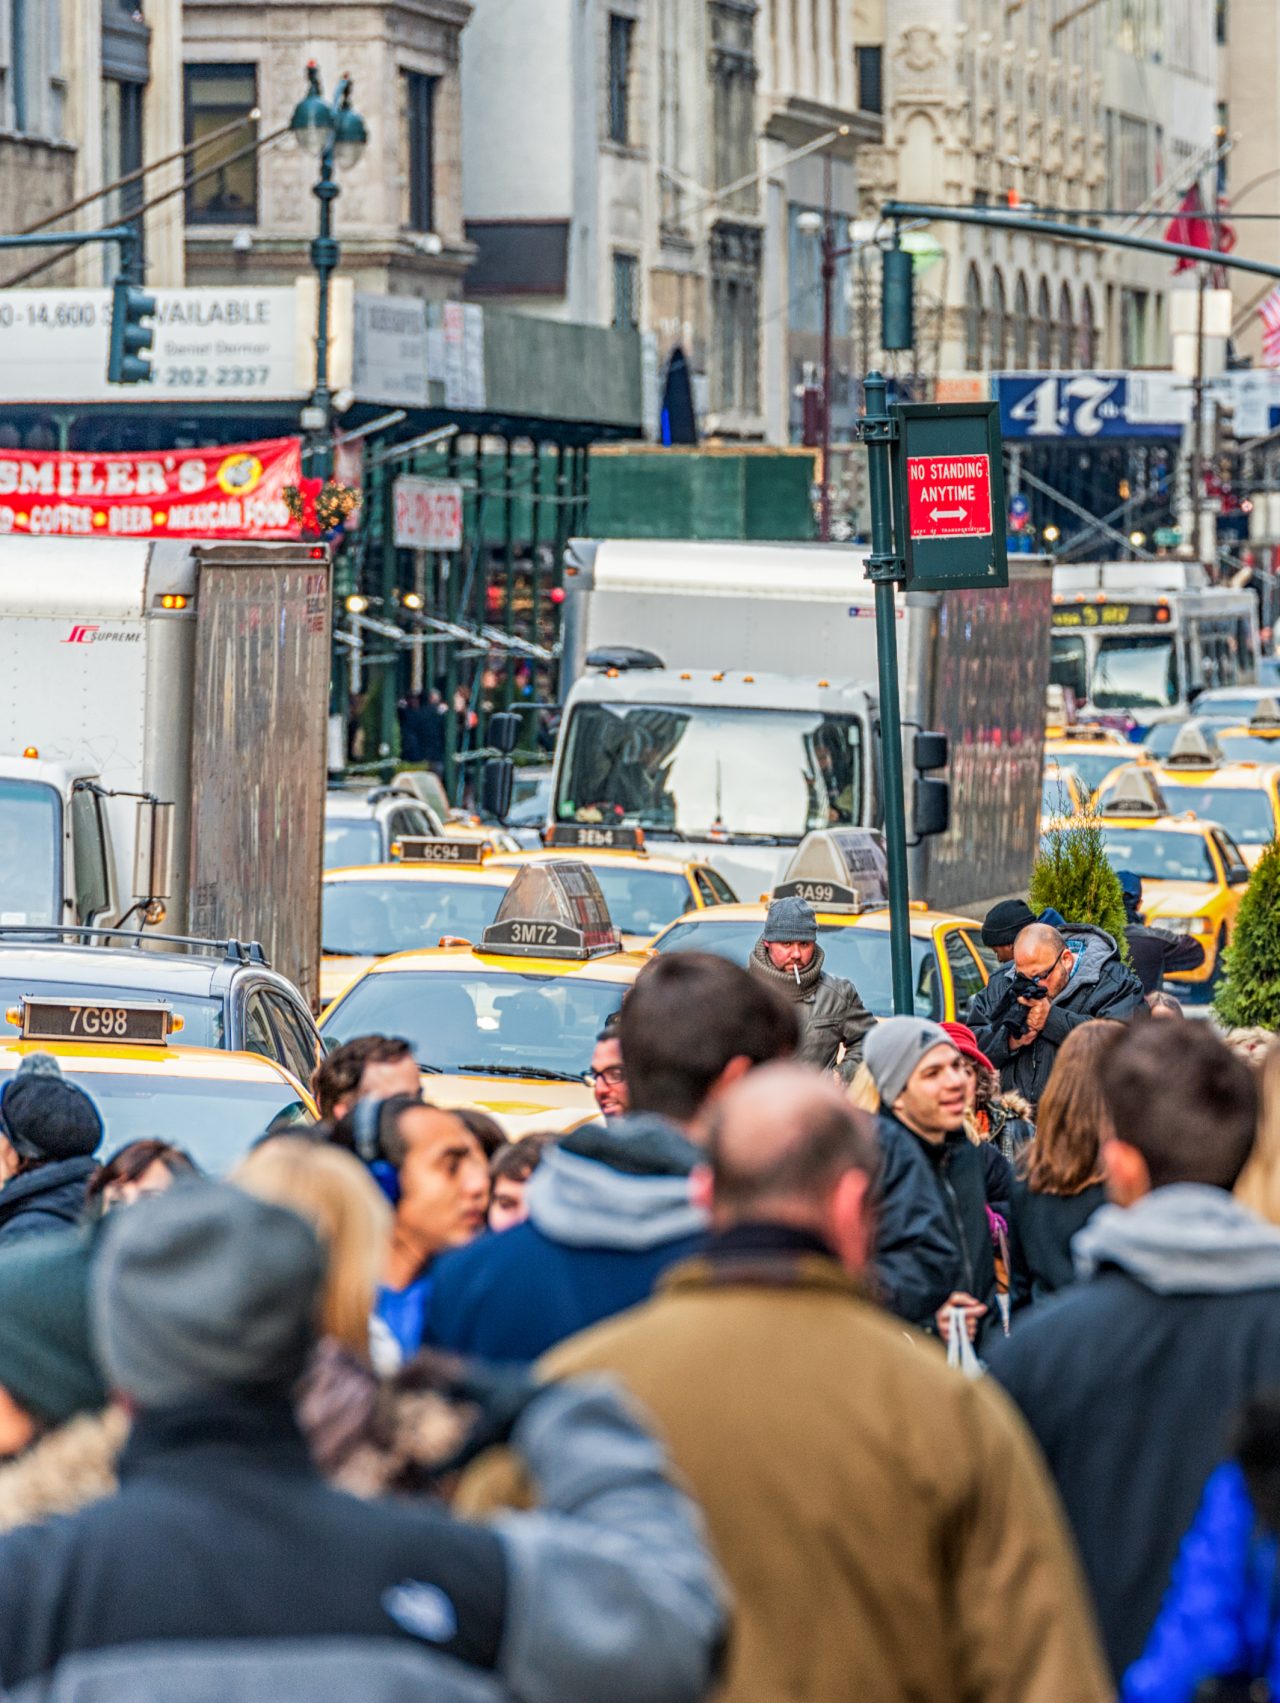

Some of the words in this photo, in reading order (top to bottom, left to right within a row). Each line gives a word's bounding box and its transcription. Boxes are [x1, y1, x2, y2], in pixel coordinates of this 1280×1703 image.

[155, 300, 270, 325] VAILABLE
[0, 456, 207, 497] SMILER'S
[911, 464, 925, 480] NO
[930, 462, 983, 480] STANDING
[920, 485, 976, 503] ANYTIME
[30, 504, 93, 534] COFFEE
[108, 504, 153, 533] BEER
[167, 502, 243, 529] MEXICAN
[244, 499, 290, 529] FOOD
[90, 632, 142, 642] SUPREME
[424, 844, 459, 859] 6C94
[795, 884, 834, 901] 3A99
[510, 924, 558, 944] 3M72
[69, 1007, 128, 1035] 7G98
